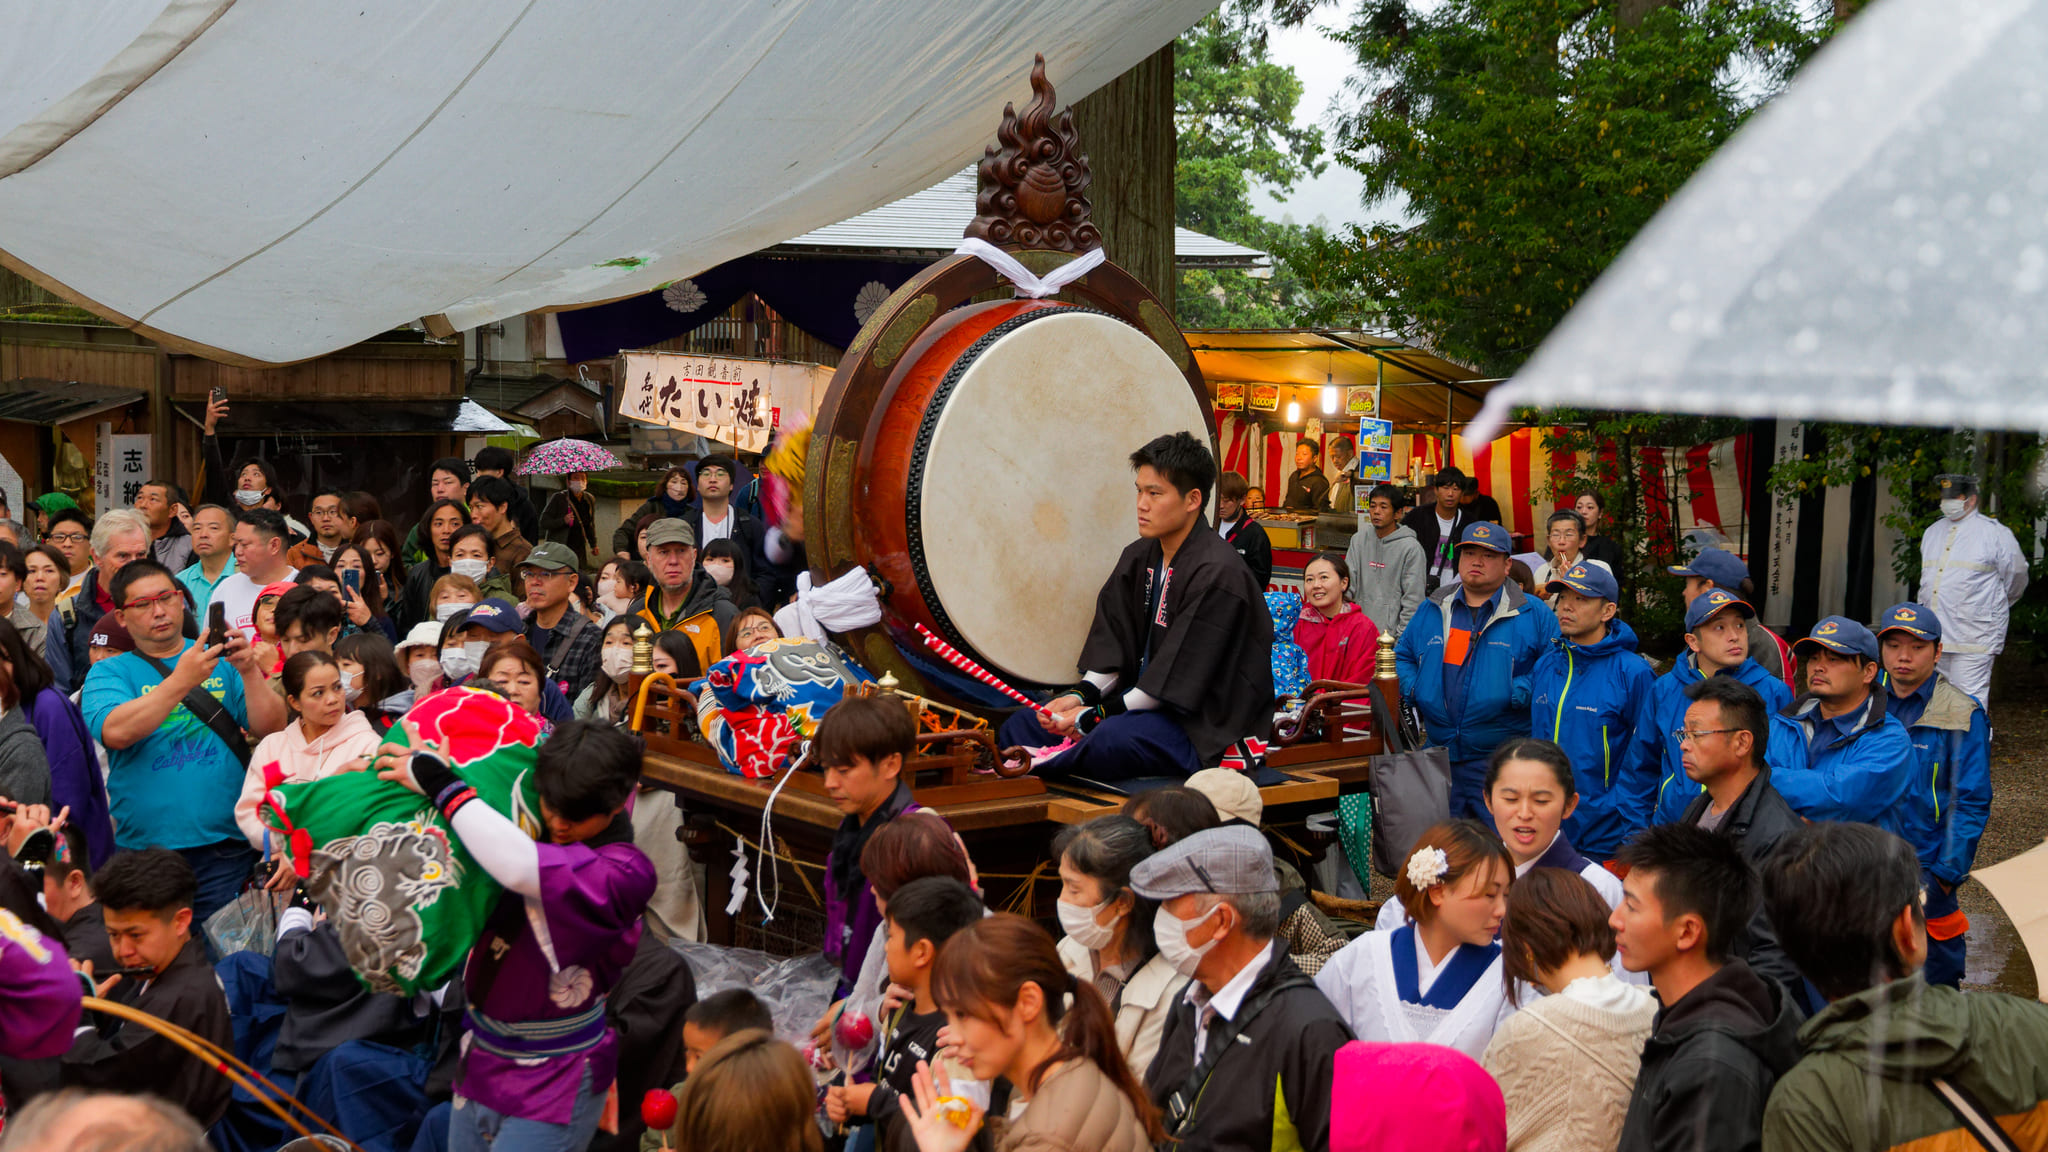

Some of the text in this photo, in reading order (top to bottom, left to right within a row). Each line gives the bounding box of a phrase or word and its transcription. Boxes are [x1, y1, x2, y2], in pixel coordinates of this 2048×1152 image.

[638, 371, 654, 416] 名代
[659, 375, 764, 428] たい焼
